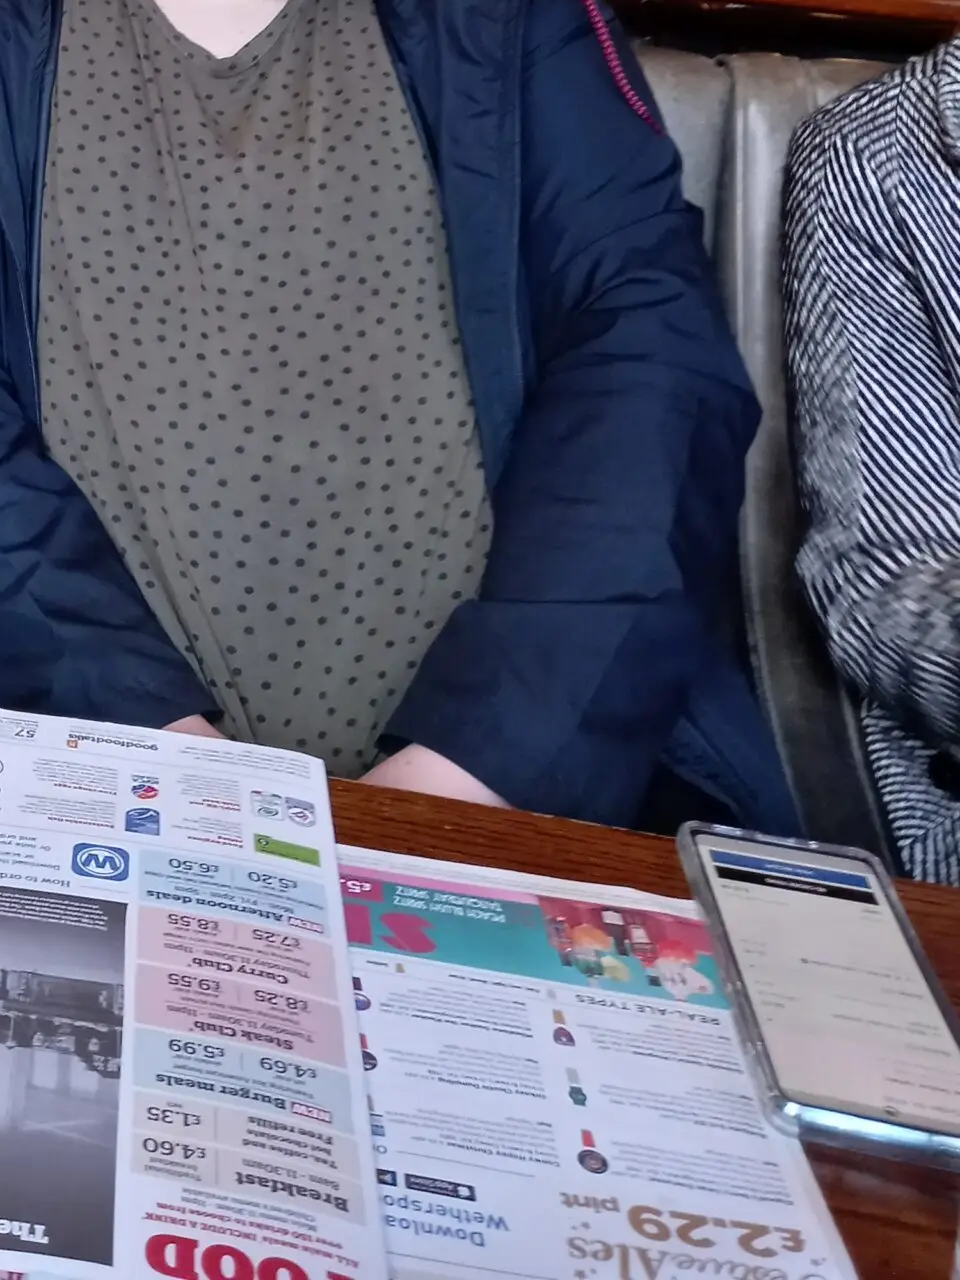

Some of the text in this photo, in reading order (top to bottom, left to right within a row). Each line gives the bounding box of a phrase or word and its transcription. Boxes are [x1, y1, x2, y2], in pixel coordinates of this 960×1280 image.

[68, 732, 158, 751] goodfoodtalks
[24, 875, 35, 883] to
[37, 876, 70, 888] How
[167, 857, 298, 891] £5.20 £6.50
[145, 888, 283, 922] Afternoon deals
[166, 912, 301, 950] £7.25 £8.55
[236, 962, 288, 985] Curry
[166, 971, 308, 1012] £8.25 £9.55
[574, 992, 721, 1026] REAL-ALE TYPES
[239, 1028, 294, 1051] Steak
[168, 1036, 318, 1080] £4.69 £5.99
[154, 1072, 286, 1110] Burger meals
[145, 1104, 200, 1129] £1.35
[141, 1135, 207, 1162] £4.60
[234, 1170, 350, 1213] Breakfast
[374, 1190, 511, 1233] Wetherspo
[558, 1187, 805, 1260] £2.29 pint
